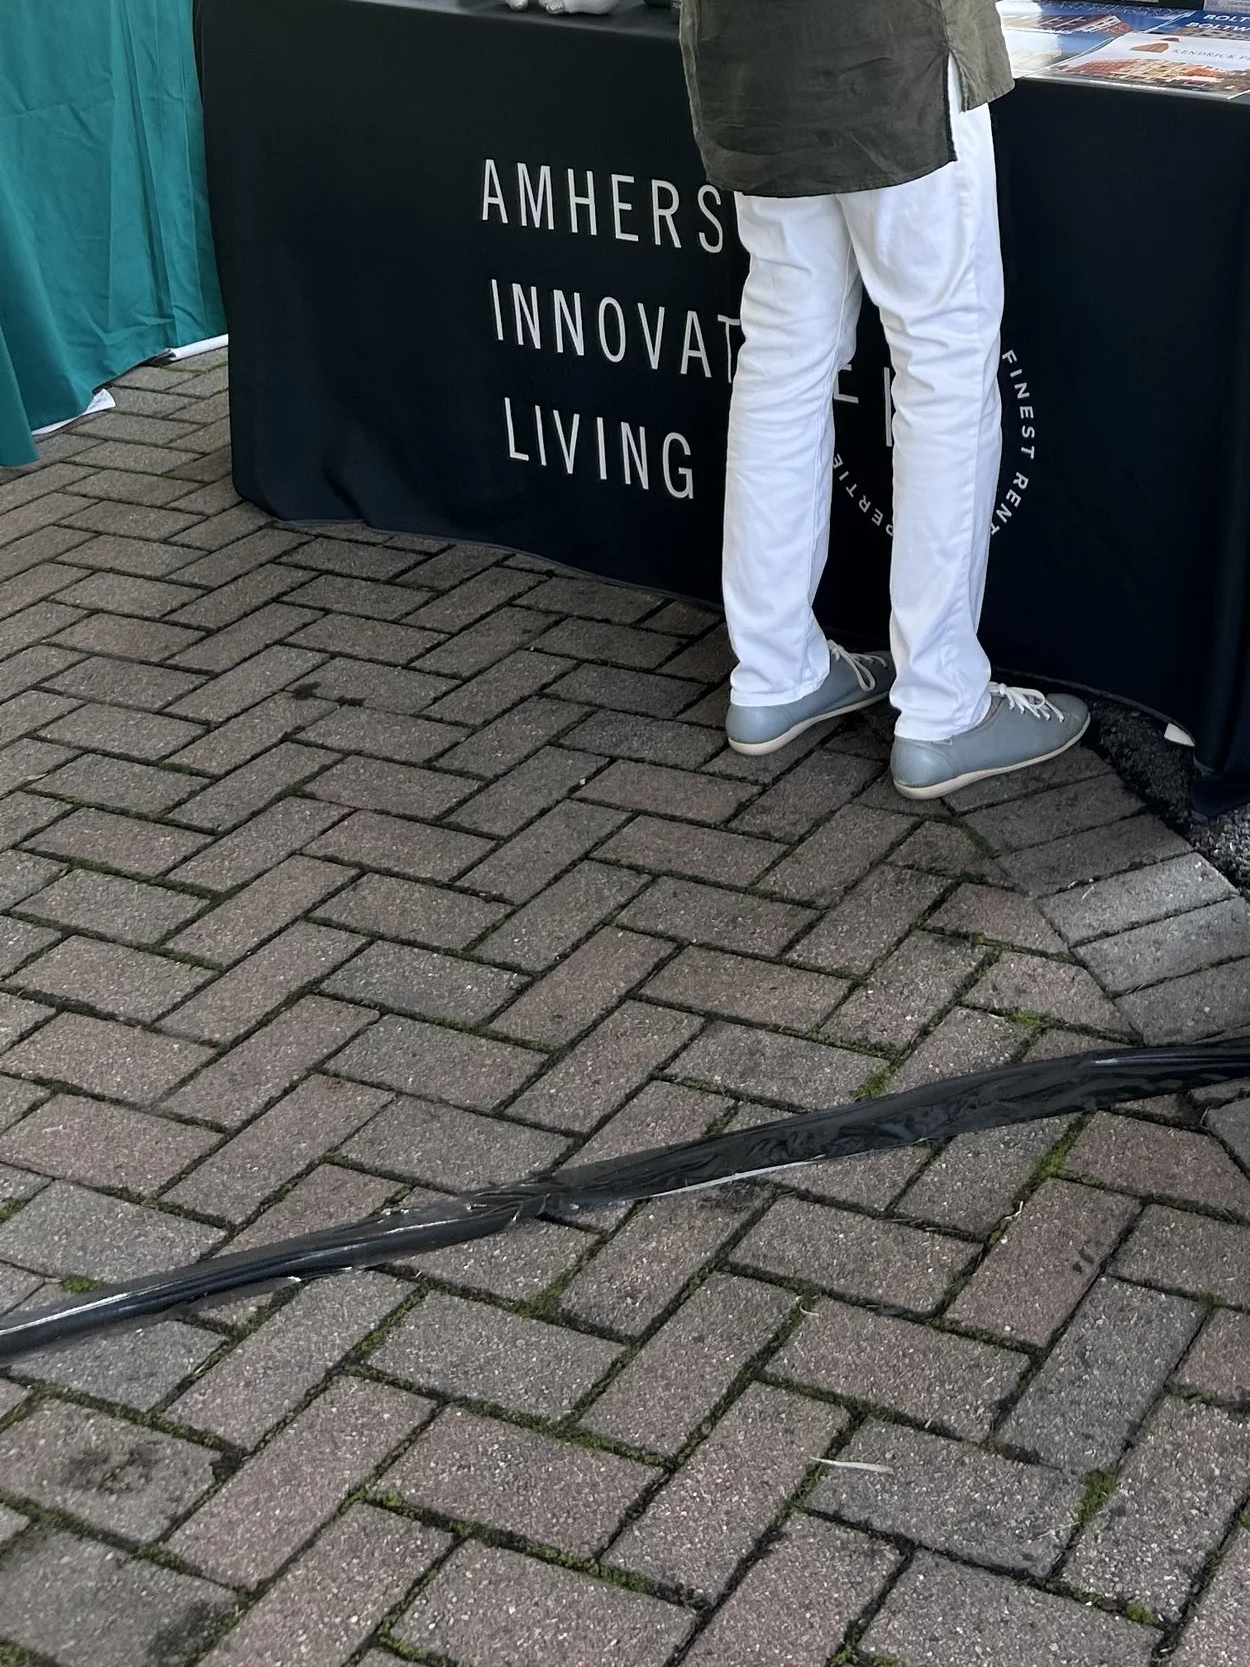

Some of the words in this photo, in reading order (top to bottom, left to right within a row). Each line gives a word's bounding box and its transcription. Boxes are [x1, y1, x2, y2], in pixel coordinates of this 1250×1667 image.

[1171, 48, 1238, 61] KENDRICK
[481, 159, 735, 256] AMHERS
[504, 396, 694, 500] LIVING
[1001, 349, 1036, 460] FINEST
